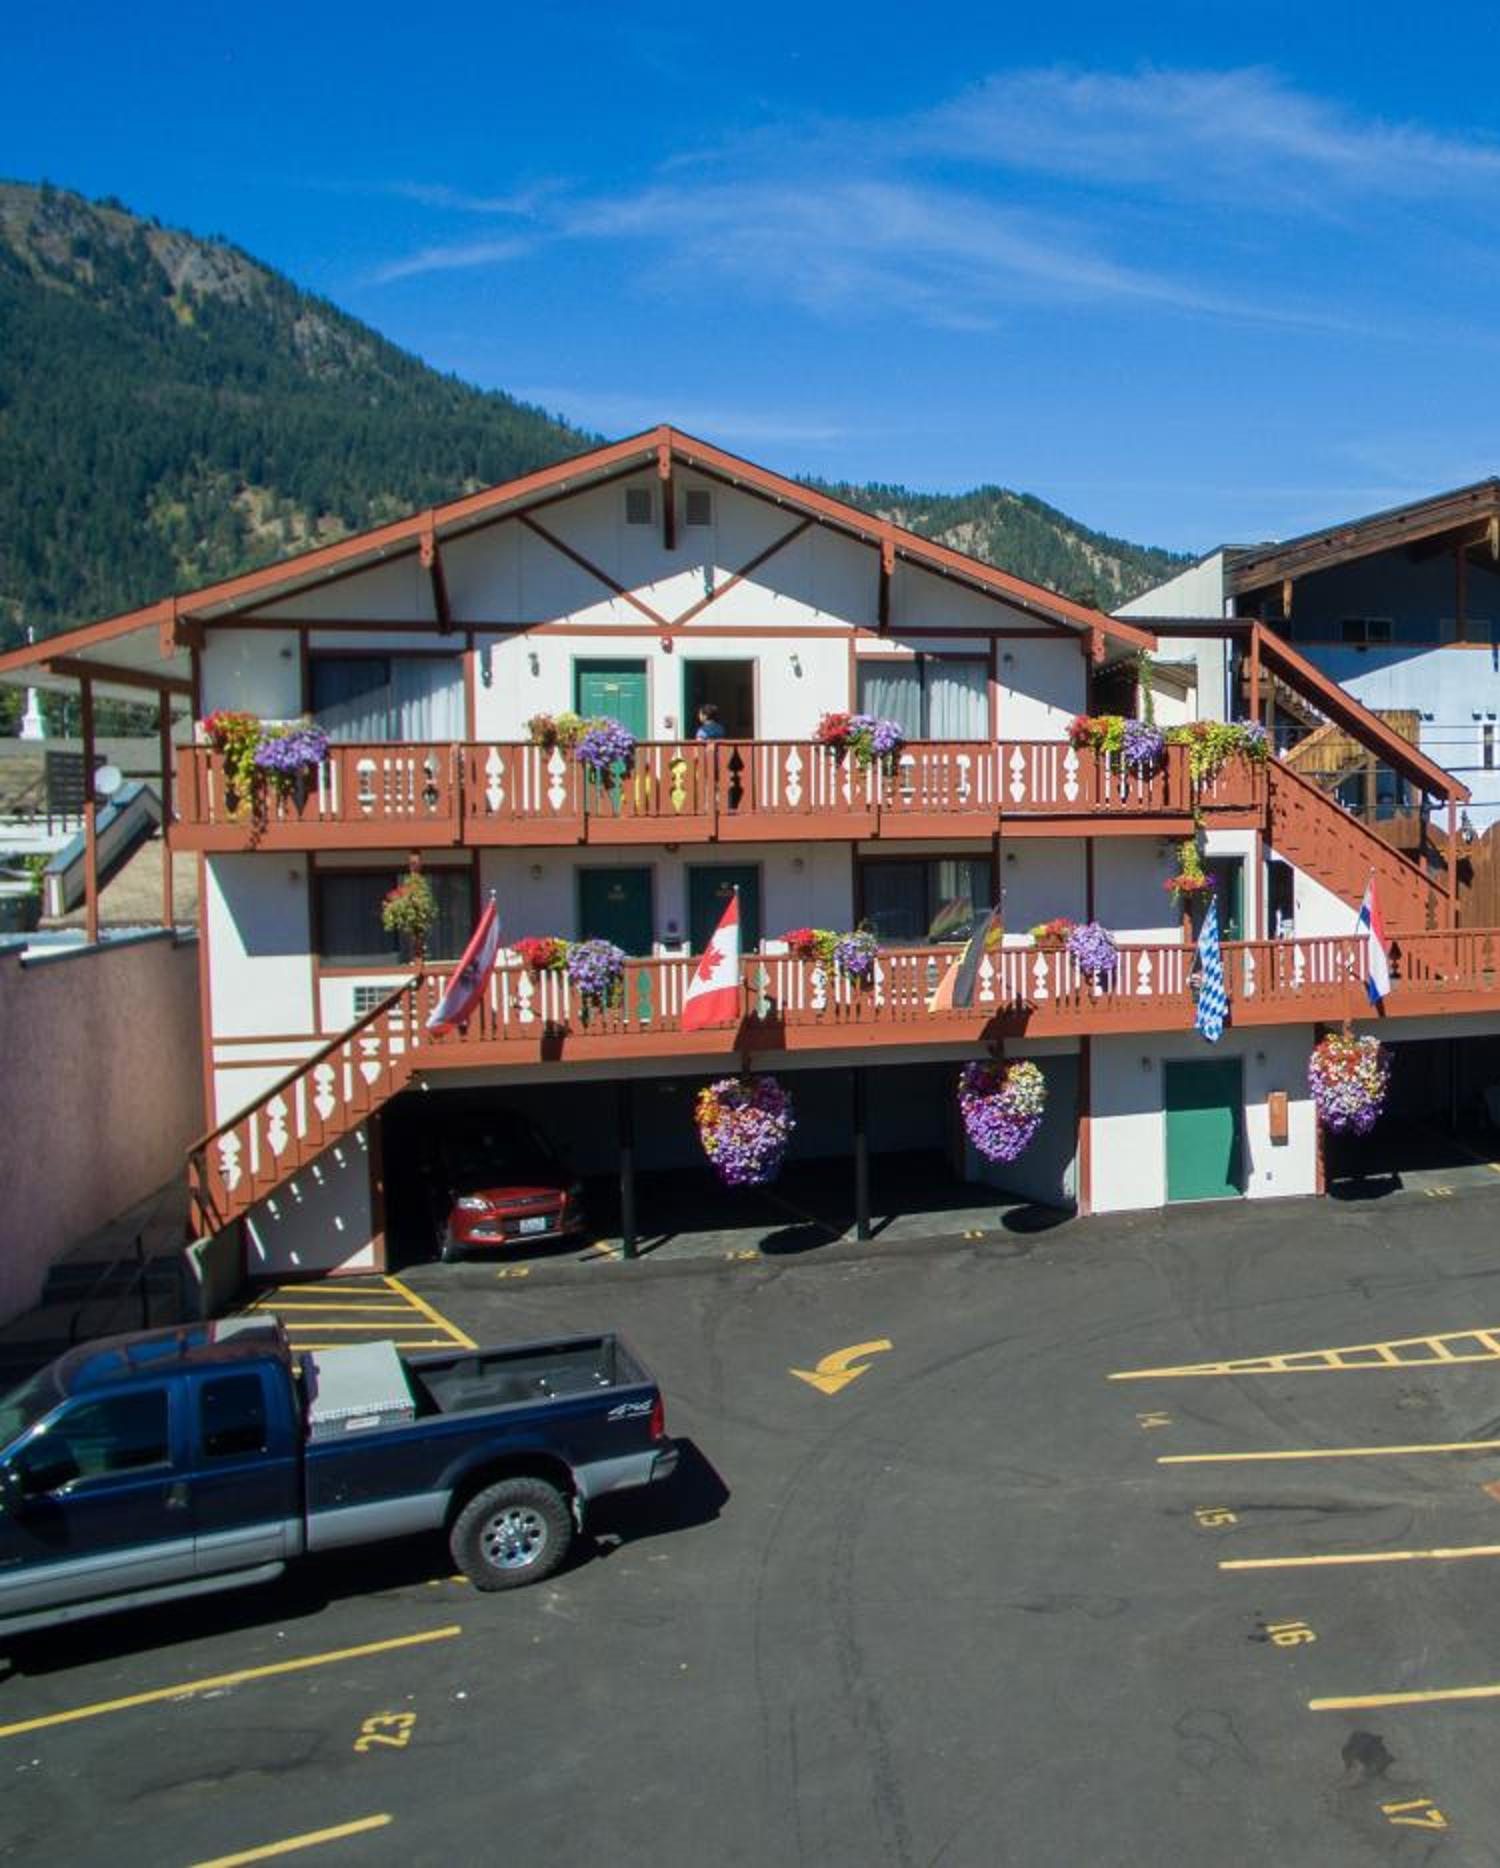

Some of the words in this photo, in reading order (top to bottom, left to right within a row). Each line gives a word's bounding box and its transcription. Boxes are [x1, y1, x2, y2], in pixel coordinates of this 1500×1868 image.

[1136, 1410, 1172, 1429] 14
[1194, 1507, 1239, 1527] 15
[1267, 1621, 1317, 1646] 16
[353, 1711, 417, 1751] 23
[1380, 1798, 1449, 1828] 17
